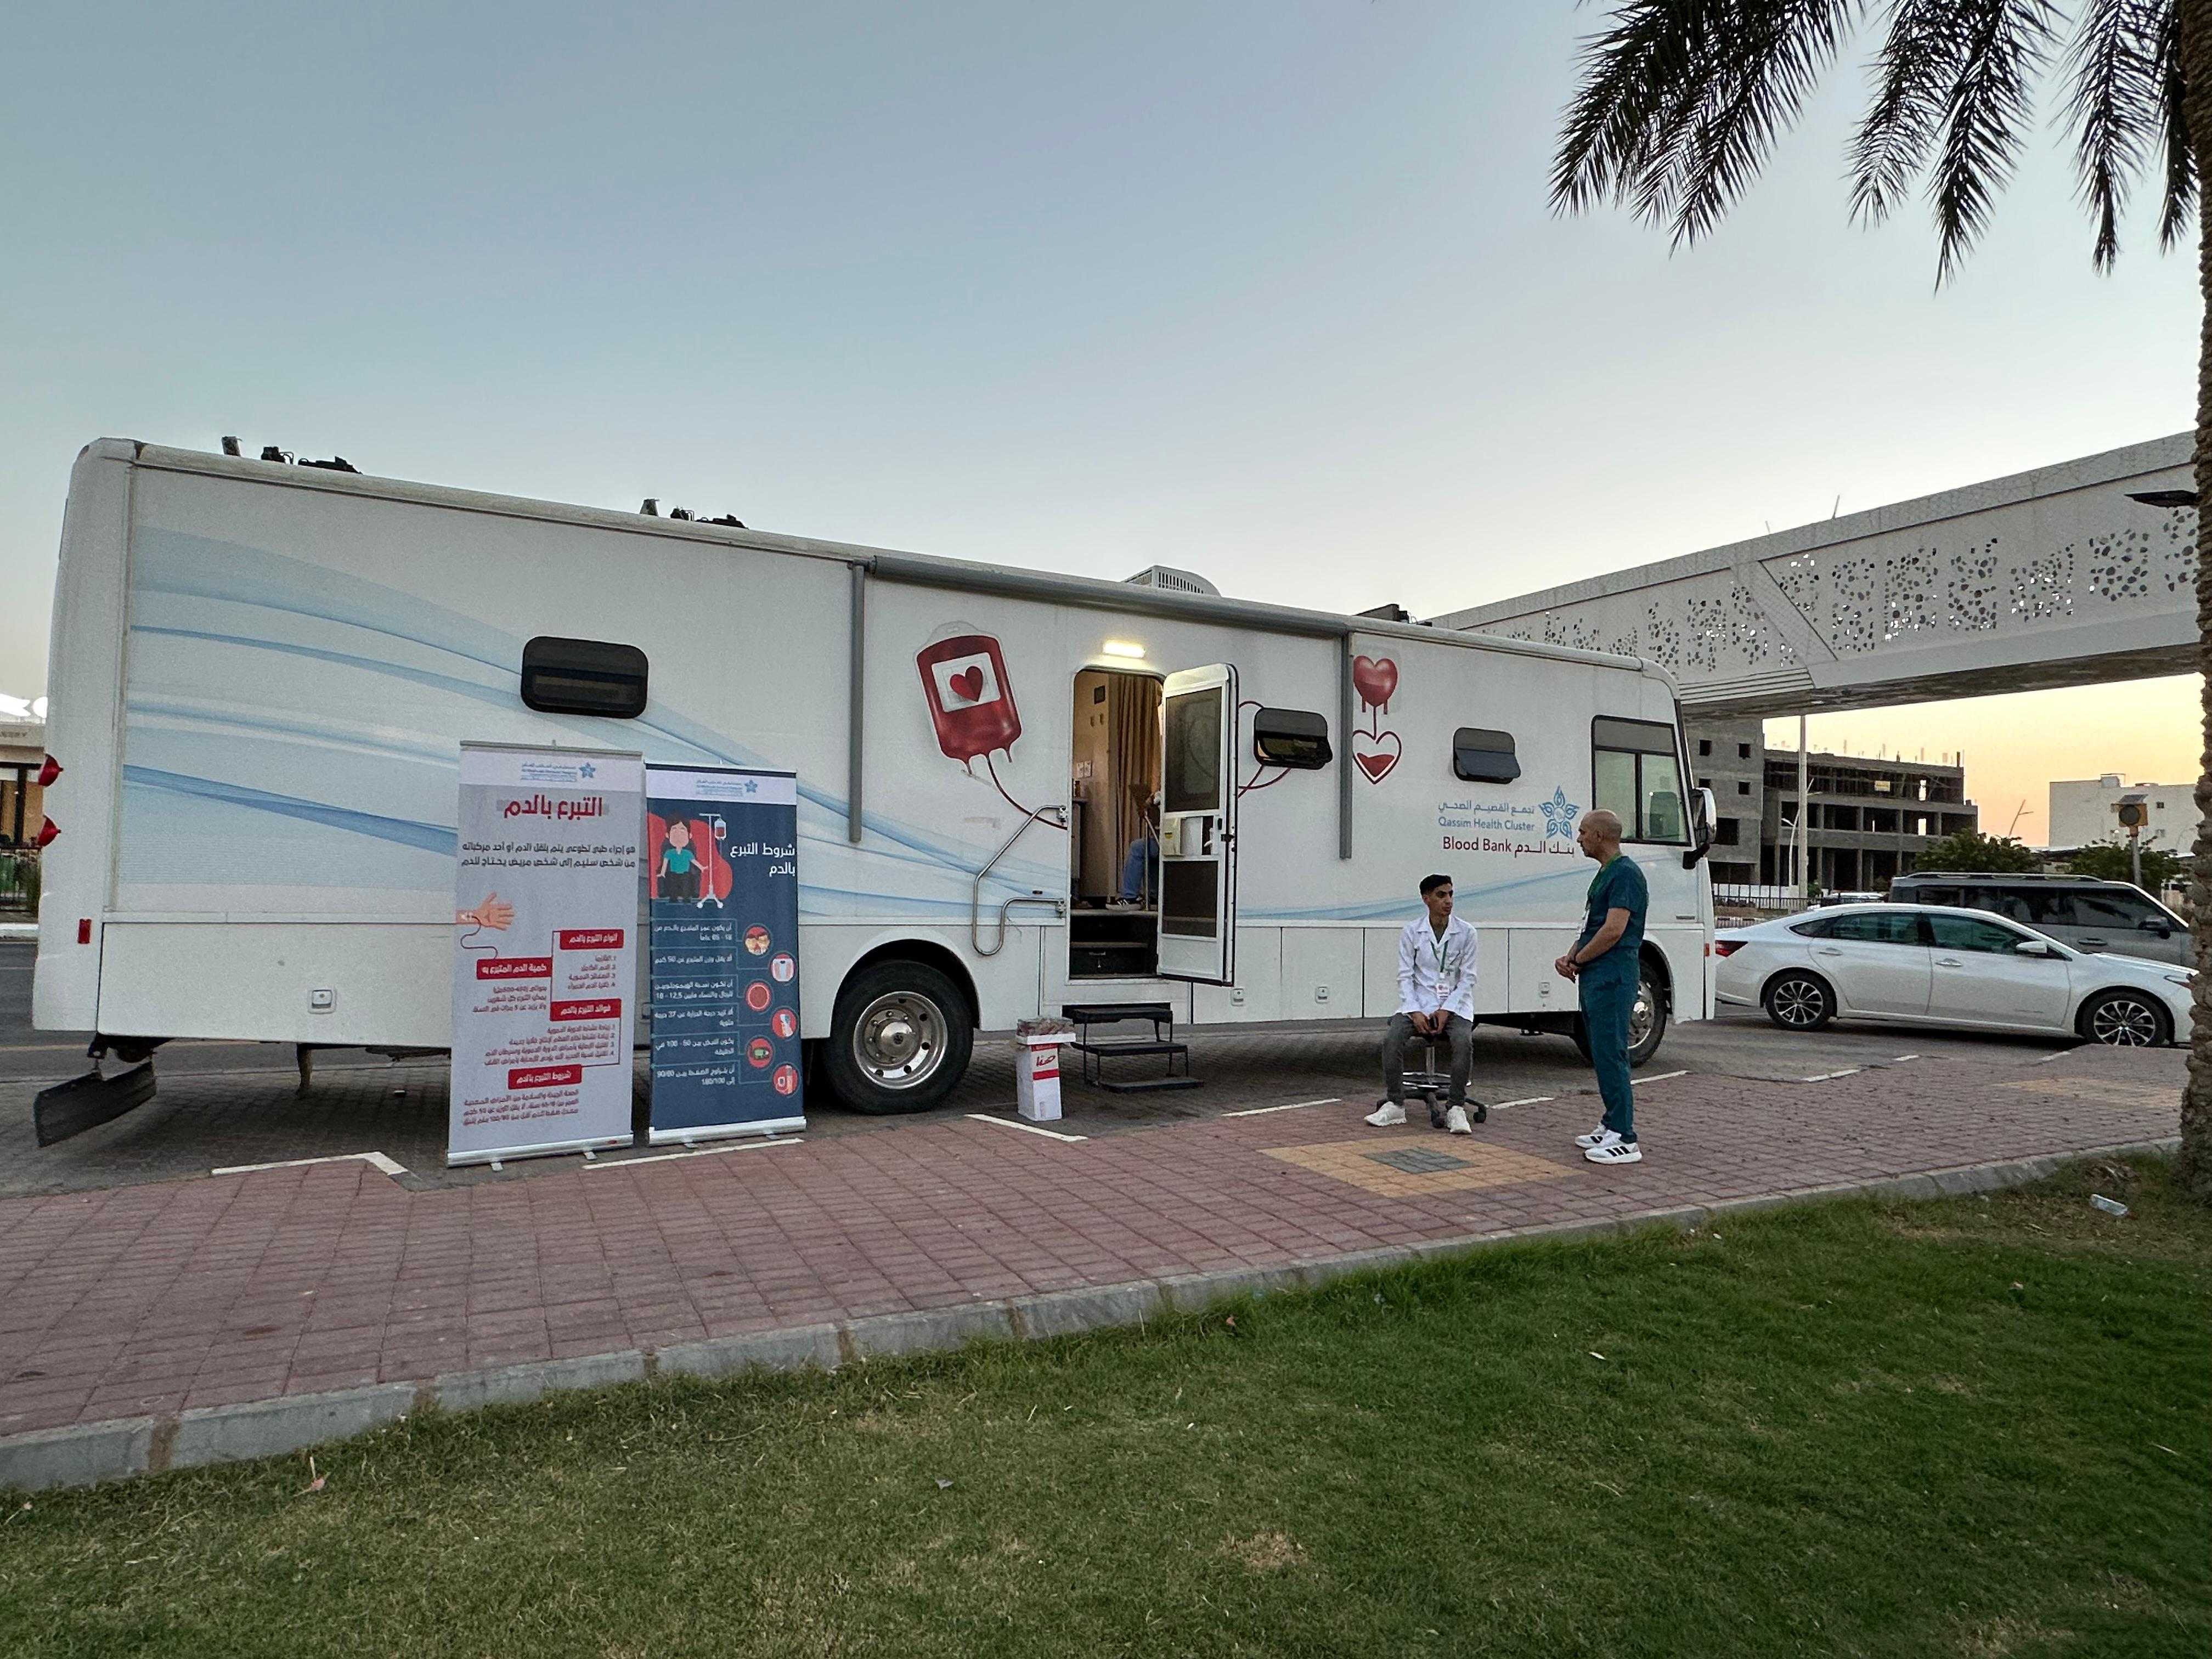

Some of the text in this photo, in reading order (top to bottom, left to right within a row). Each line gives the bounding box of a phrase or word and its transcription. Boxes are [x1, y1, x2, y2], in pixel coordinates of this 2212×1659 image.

[504, 795, 602, 820] التبرع بالدم
[1438, 800, 1534, 816] تجمع القصيم الصحي
[1438, 817, 1536, 831] Qassim Health Cluster
[730, 842, 795, 858] شروط التبرع
[1443, 836, 1511, 853] Blood Bank
[1515, 841, 1575, 857] بنك الدم
[769, 861, 795, 877] بالدم
